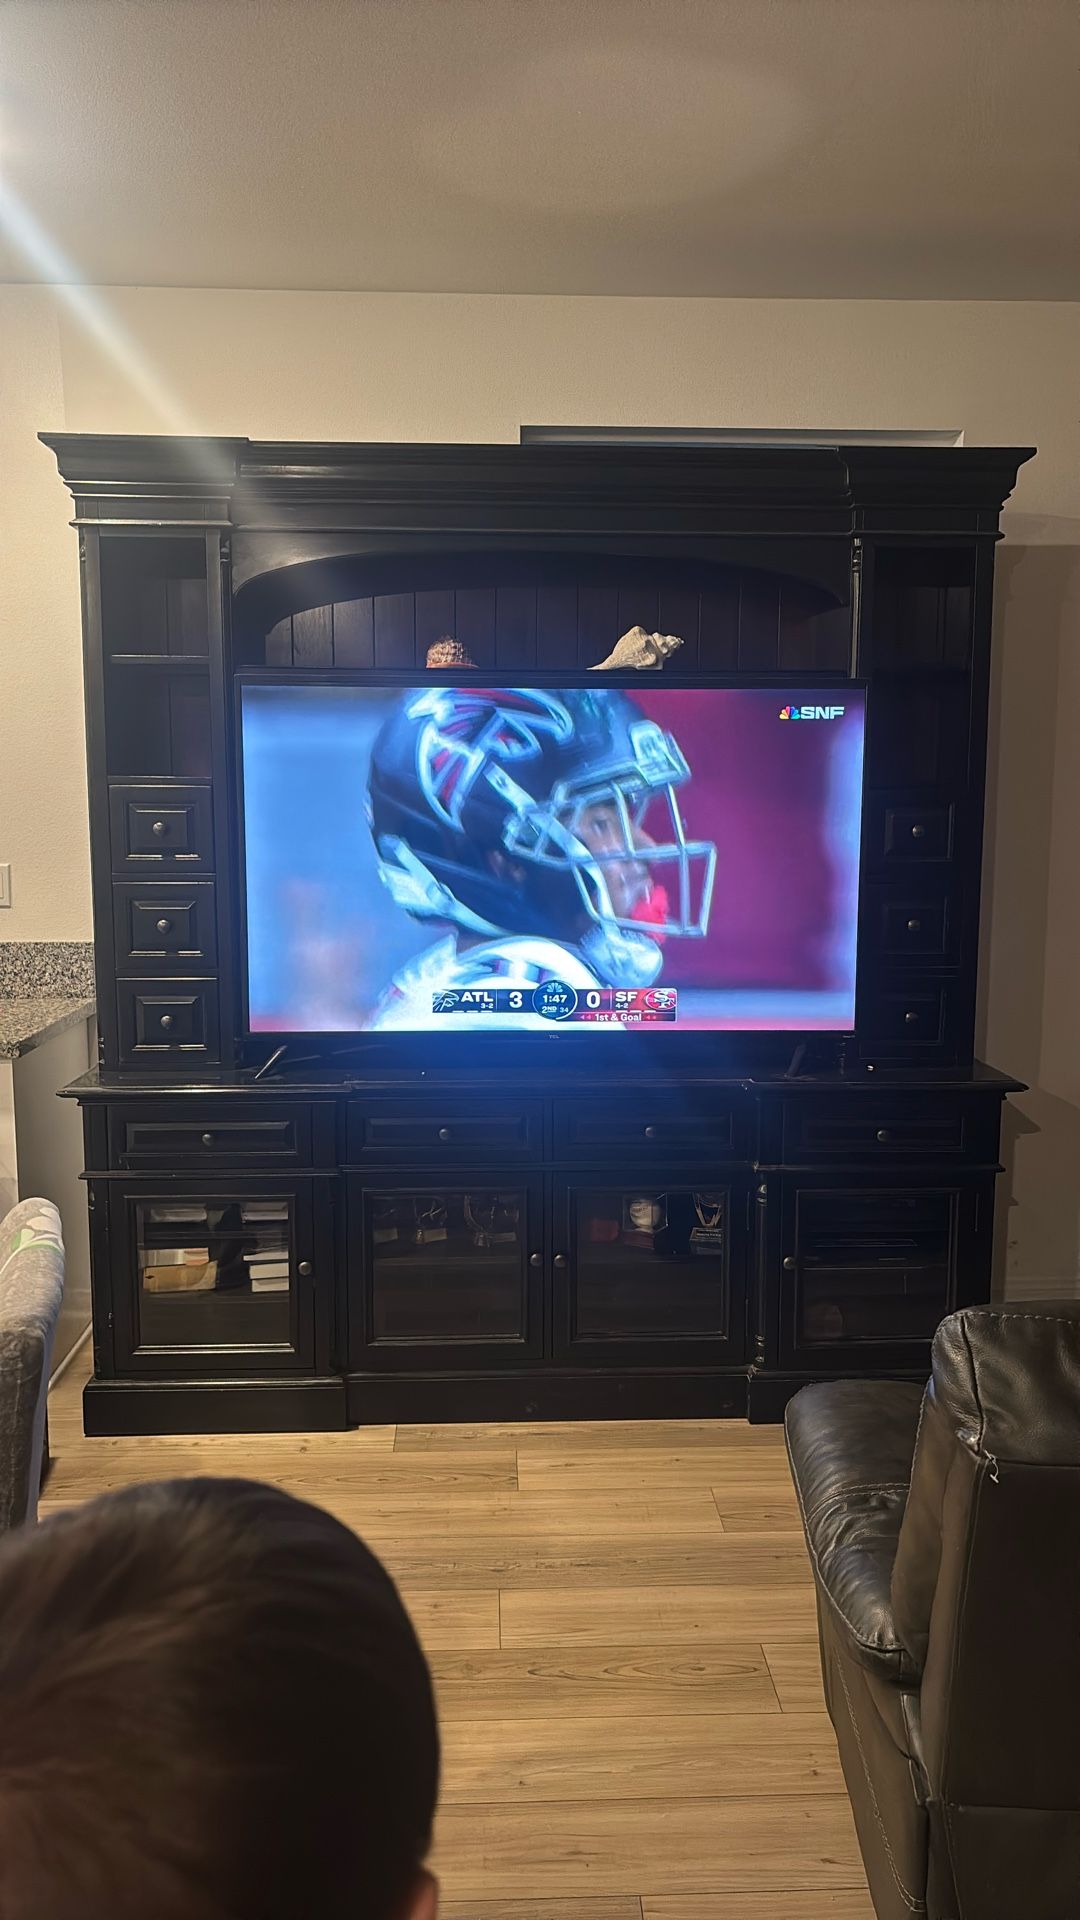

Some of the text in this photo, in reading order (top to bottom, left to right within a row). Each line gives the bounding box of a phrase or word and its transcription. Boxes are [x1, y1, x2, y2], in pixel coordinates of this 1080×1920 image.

[801, 706, 845, 720] SNF
[460, 991, 638, 1008] ATL 3 1:47 0 SF
[541, 1005, 557, 1014] 2ND
[595, 1013, 642, 1021] 1st & Goal
